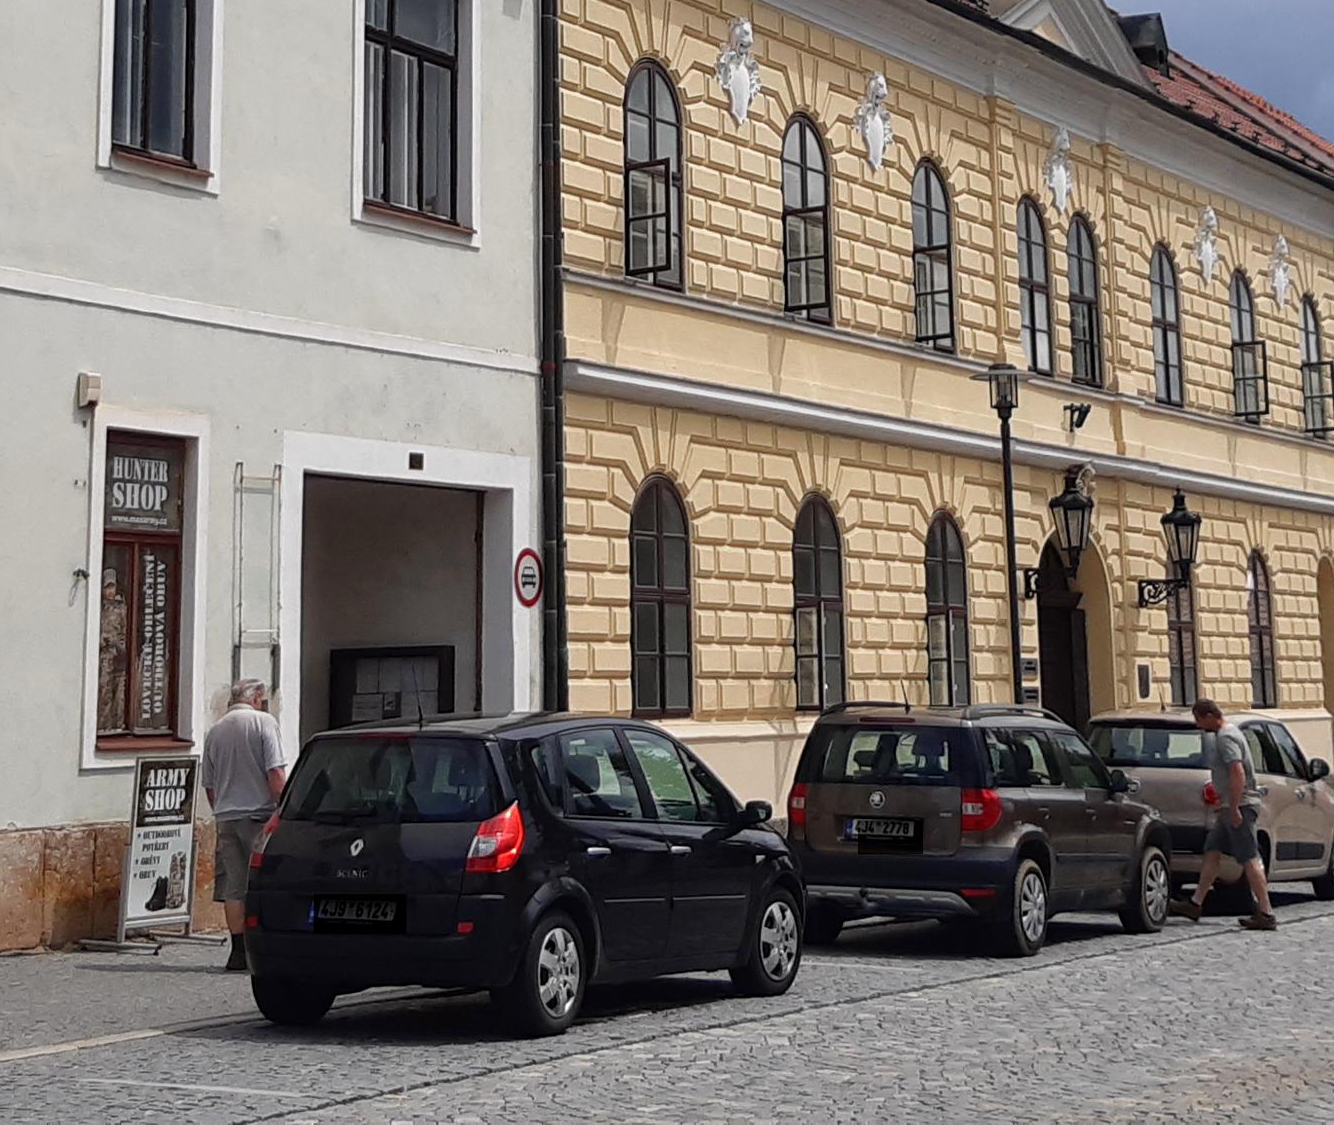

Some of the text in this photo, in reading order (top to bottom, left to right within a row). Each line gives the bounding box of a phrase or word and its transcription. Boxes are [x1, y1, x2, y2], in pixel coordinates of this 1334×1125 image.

[112, 456, 169, 482] HUNTER
[112, 482, 168, 511] SHOP
[145, 768, 190, 788] ARMY
[144, 788, 186, 812] SHOP
